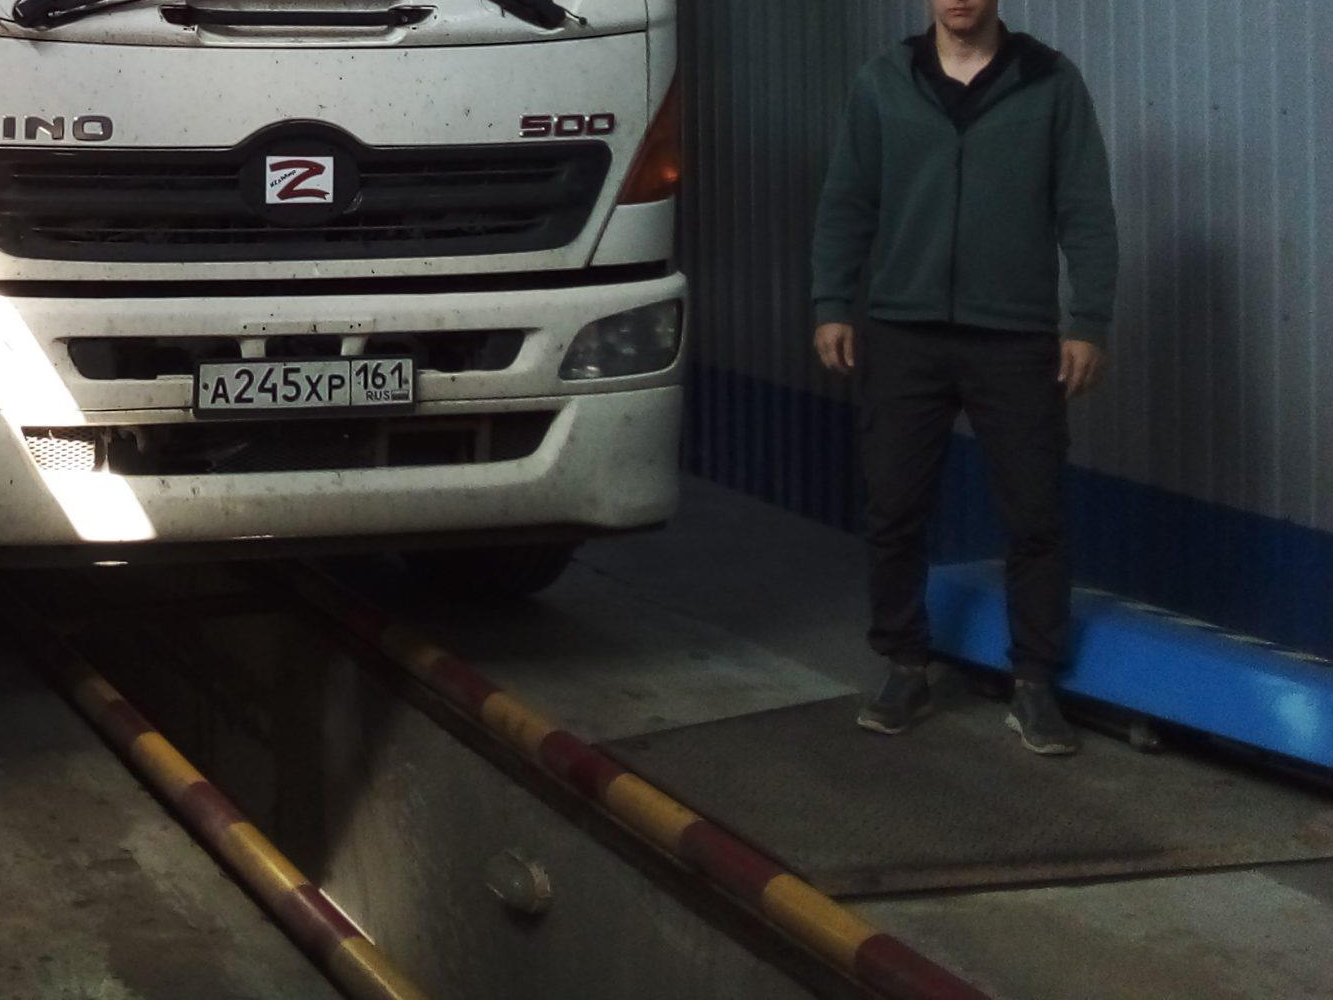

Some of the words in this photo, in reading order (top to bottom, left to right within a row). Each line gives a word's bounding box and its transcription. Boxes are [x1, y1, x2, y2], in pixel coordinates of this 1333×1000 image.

[518, 112, 615, 138] 500
[355, 361, 404, 389] 161
[366, 389, 390, 401] RUS
